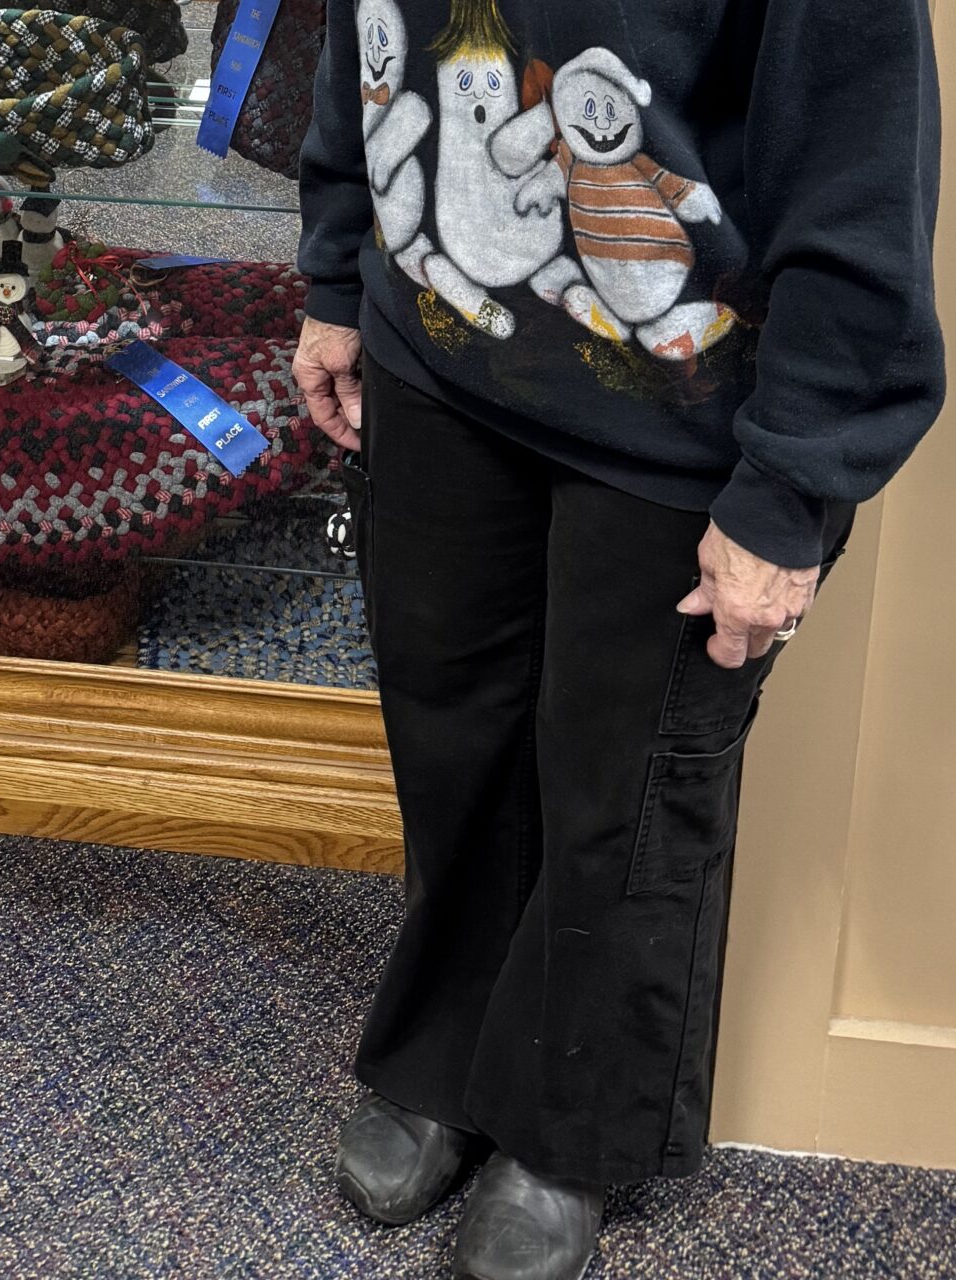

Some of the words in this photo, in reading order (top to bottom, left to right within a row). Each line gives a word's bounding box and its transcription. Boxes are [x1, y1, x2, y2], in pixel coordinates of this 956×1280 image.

[217, 84, 236, 100] FIRST
[208, 110, 229, 127] PLACE
[156, 373, 188, 398] SANDWICH
[197, 407, 221, 431] FIRST
[215, 422, 244, 450] PLACE
